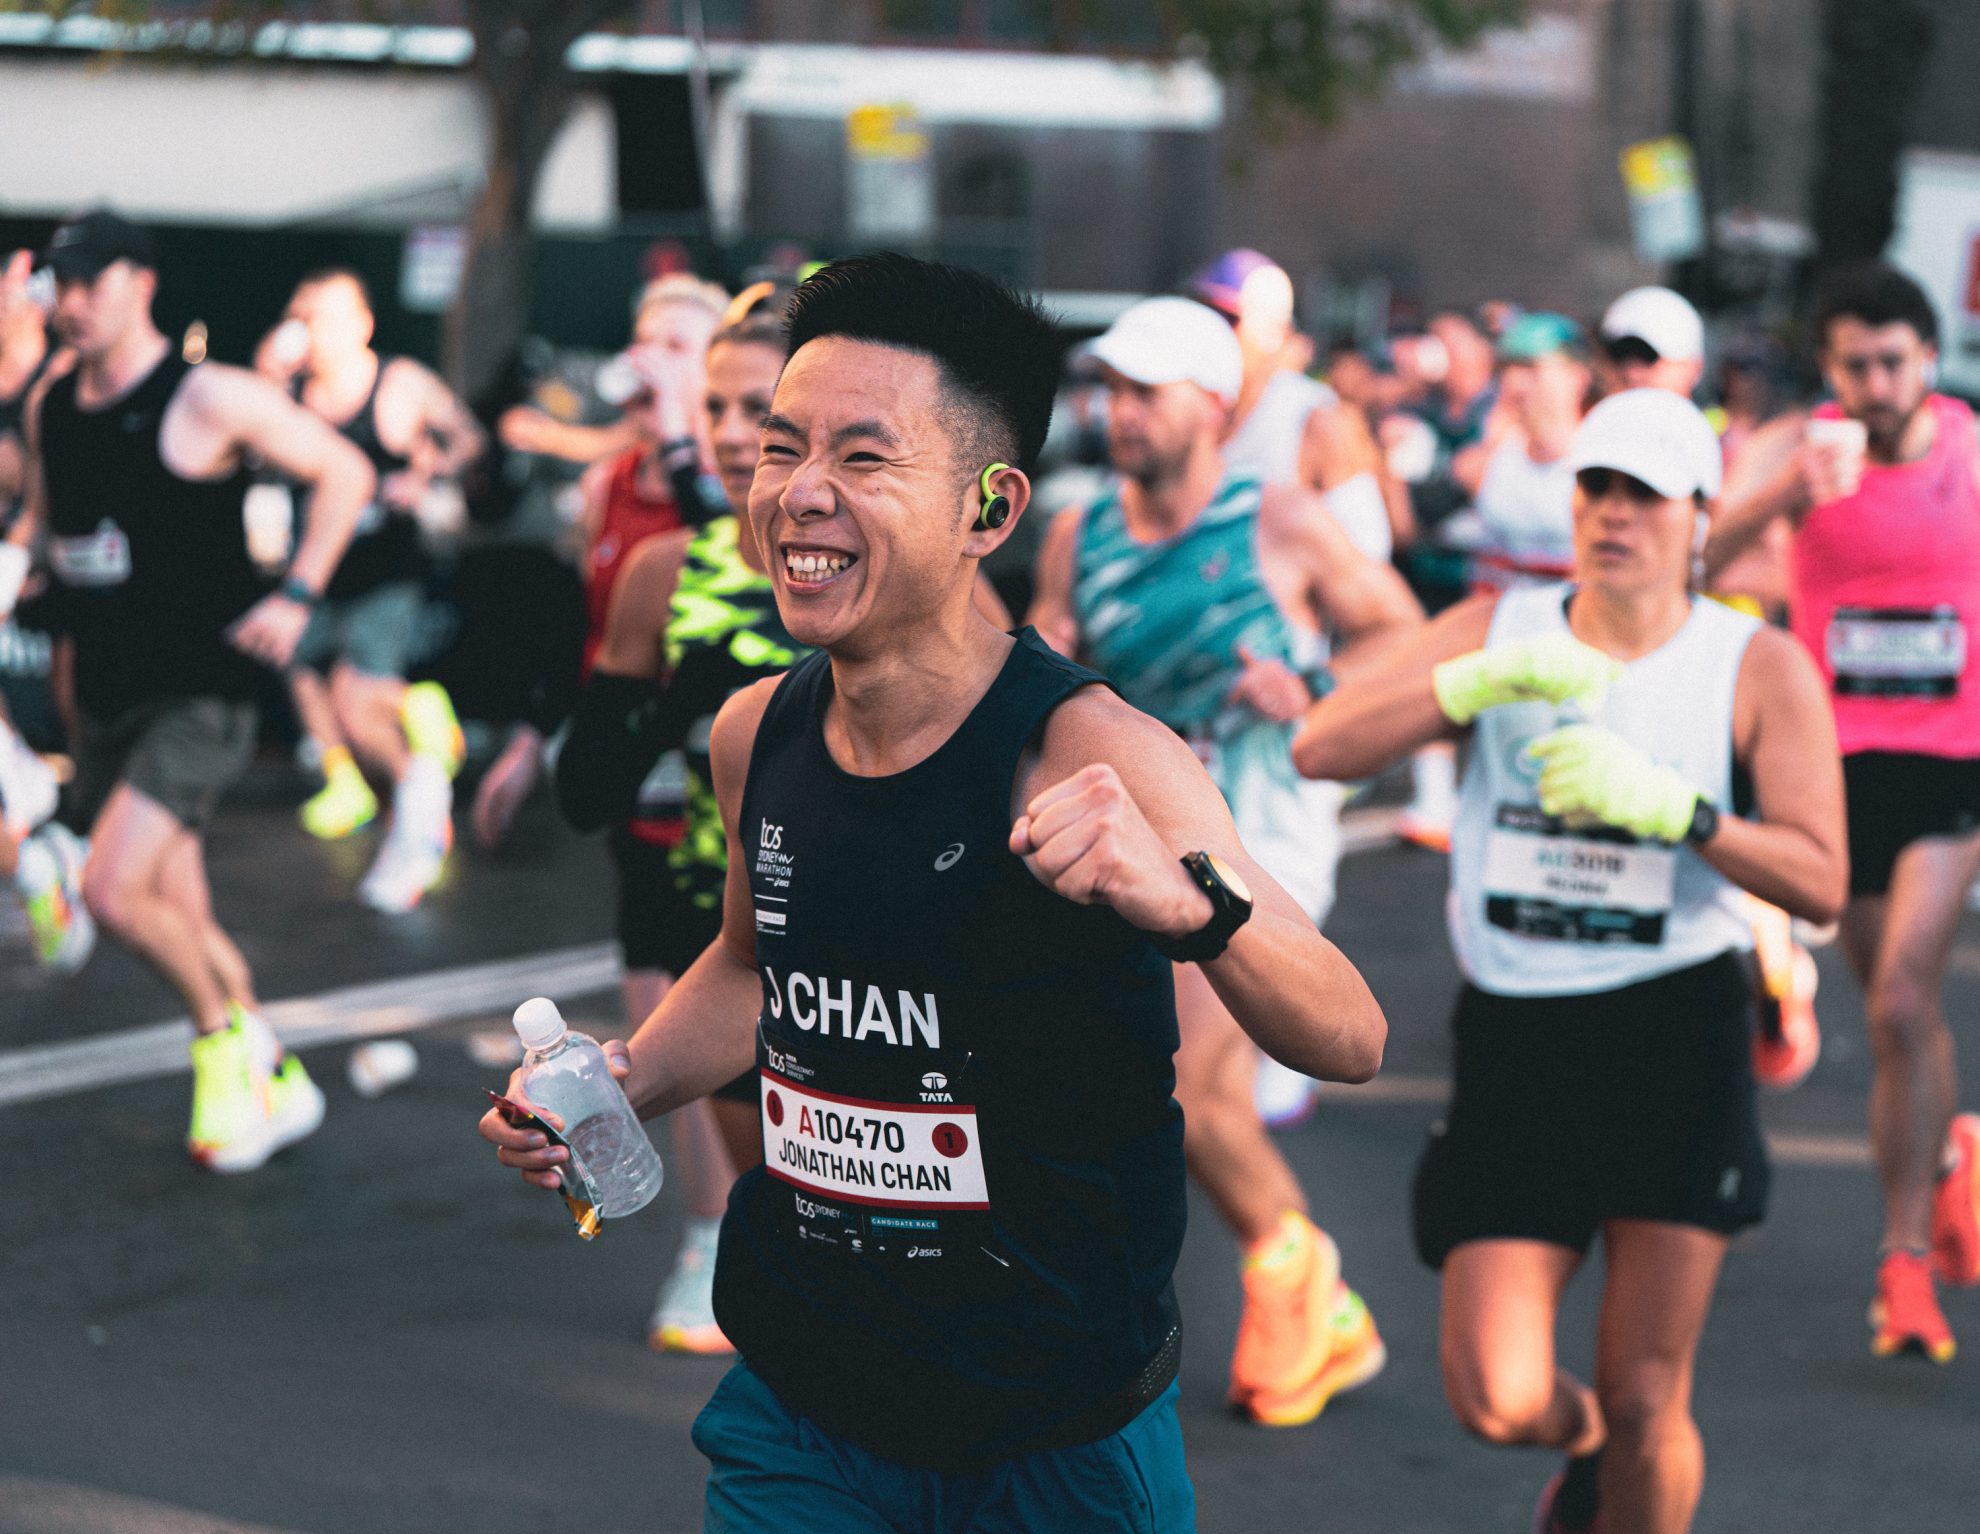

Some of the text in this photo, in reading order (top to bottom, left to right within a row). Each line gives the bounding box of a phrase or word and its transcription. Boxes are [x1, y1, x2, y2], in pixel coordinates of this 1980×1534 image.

[760, 817, 783, 850] tcs
[758, 849, 779, 863] SYDNEY
[756, 862, 793, 877] MARATHON
[765, 966, 940, 1049] J CHAN
[768, 1044, 786, 1073] tcs
[919, 1092, 953, 1103] TATA
[799, 1104, 905, 1154] A10470
[944, 1132, 953, 1150] 1
[779, 1138, 952, 1192] JONATHAN CHAN
[795, 1192, 840, 1219] tcs SYDNEY
[871, 1218, 937, 1229] CANDIDATE RACE
[918, 1248, 942, 1258] asics
